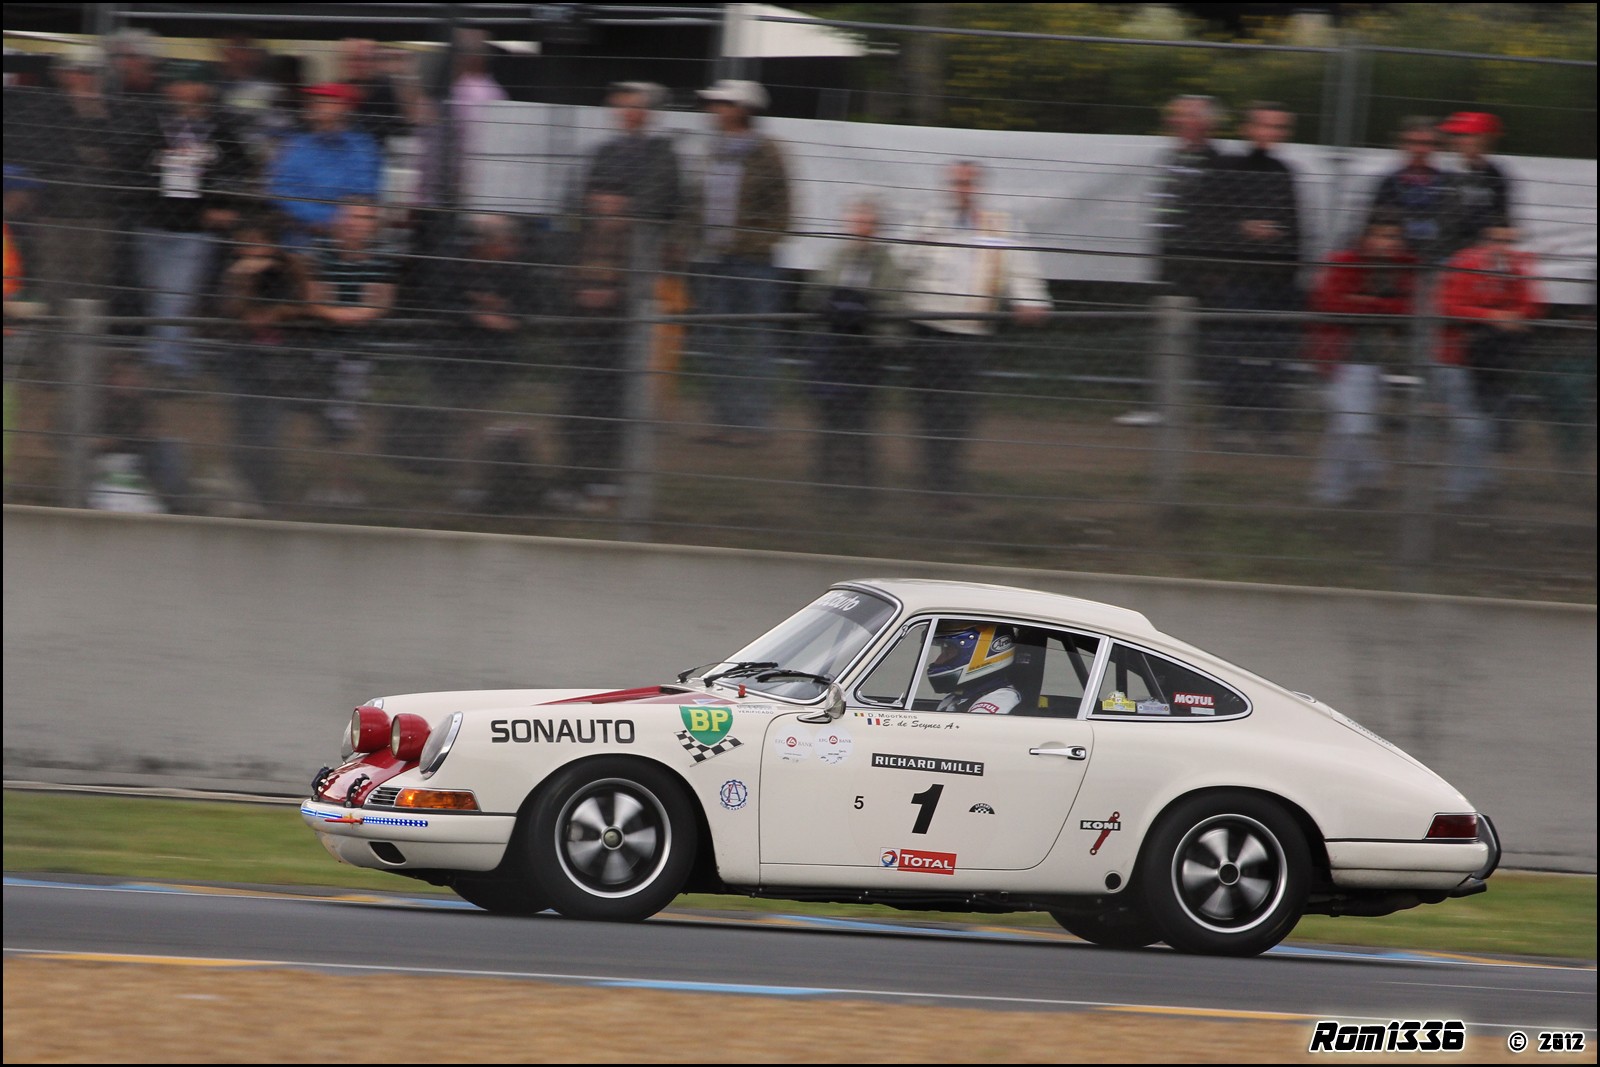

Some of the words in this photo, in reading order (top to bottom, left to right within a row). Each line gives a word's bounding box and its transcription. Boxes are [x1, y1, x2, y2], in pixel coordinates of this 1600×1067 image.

[1174, 694, 1214, 706] MOTUL
[688, 709, 729, 732] BP
[882, 718, 893, 727] E.
[490, 719, 635, 744] SONAUTO
[875, 755, 936, 769] RICHARD
[940, 761, 982, 774] MILLE
[853, 795, 864, 810] 5
[911, 783, 945, 835] 1
[1082, 821, 1119, 830] KONI
